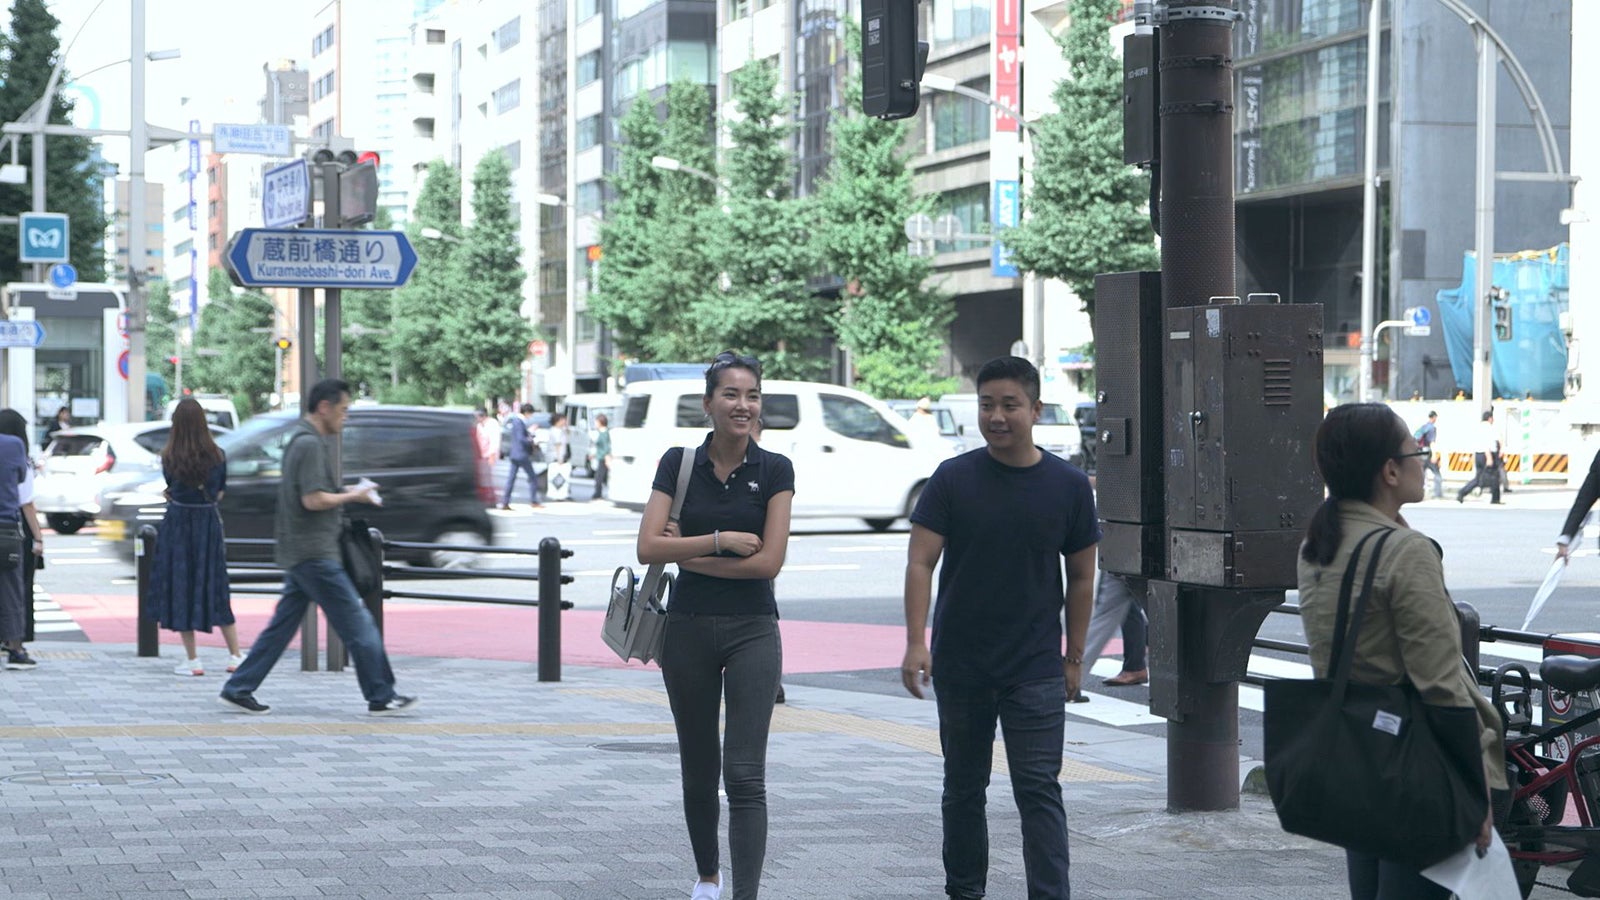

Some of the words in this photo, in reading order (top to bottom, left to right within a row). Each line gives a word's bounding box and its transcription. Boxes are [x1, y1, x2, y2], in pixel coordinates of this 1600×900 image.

[262, 237, 385, 264] 蔵前橋通り
[257, 263, 366, 278] Kuramaebashi-dori
[369, 266, 393, 279] Ave.
